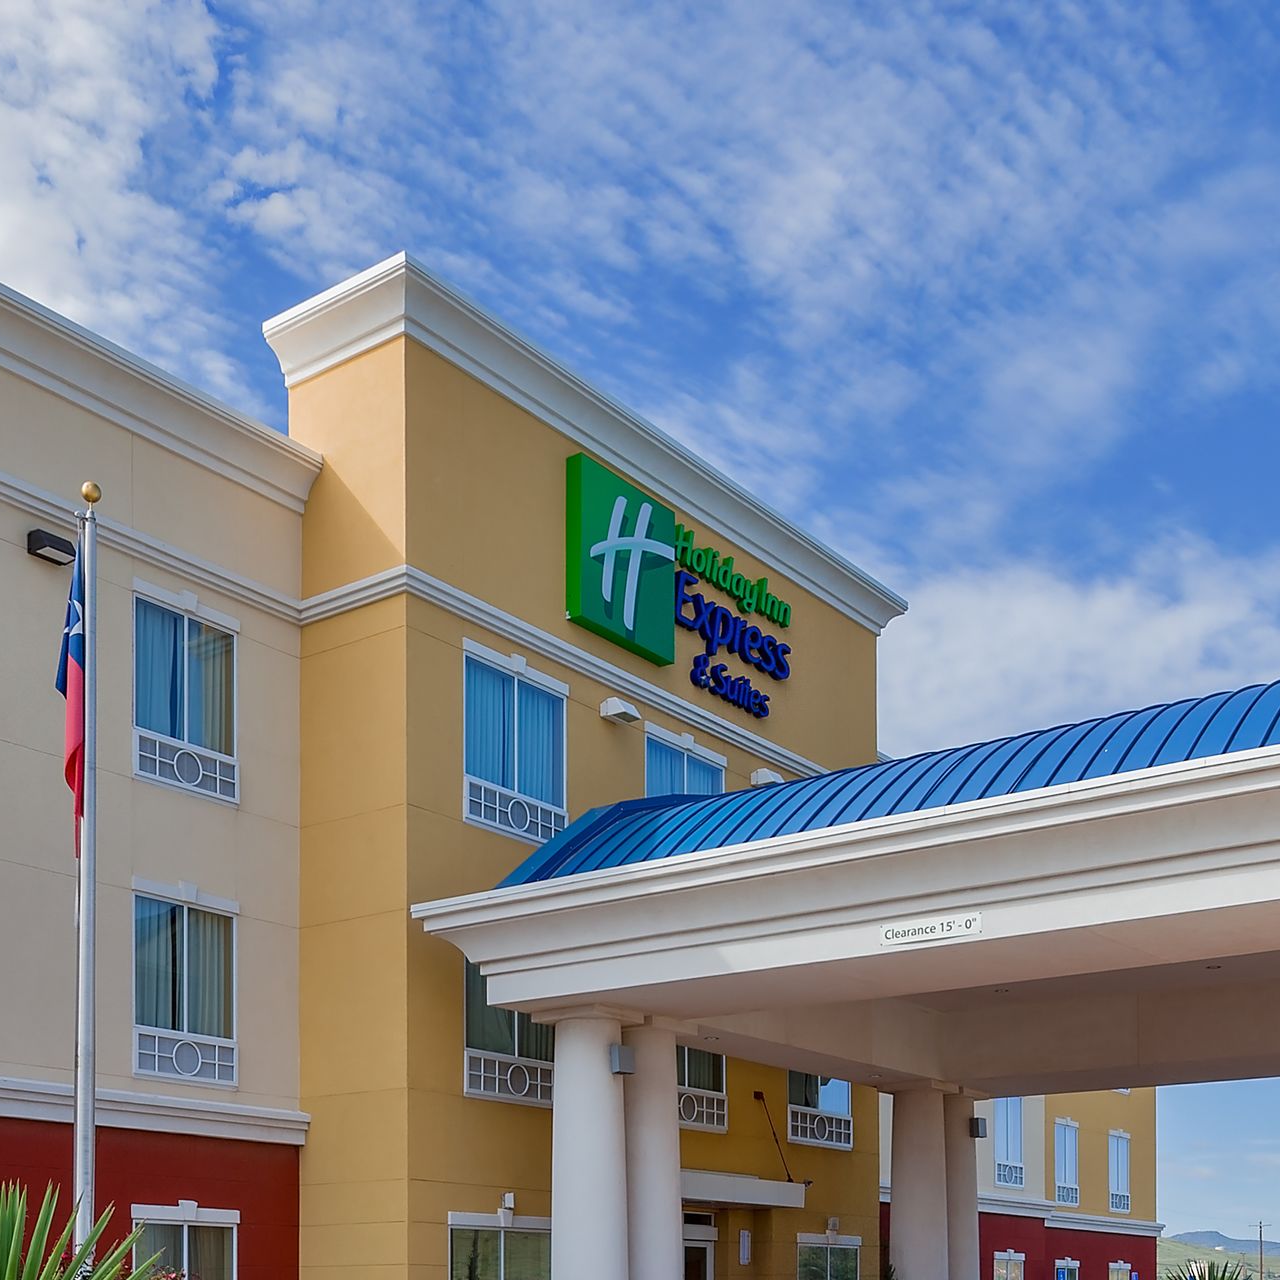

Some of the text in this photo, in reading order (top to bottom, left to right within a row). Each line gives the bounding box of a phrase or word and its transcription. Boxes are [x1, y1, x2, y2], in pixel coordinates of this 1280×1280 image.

[675, 523, 792, 628] Holiday Inn
[675, 570, 792, 681] Express
[690, 654, 770, 719] & Suites
[884, 925, 937, 940] Clearance
[940, 920, 956, 933] 15'
